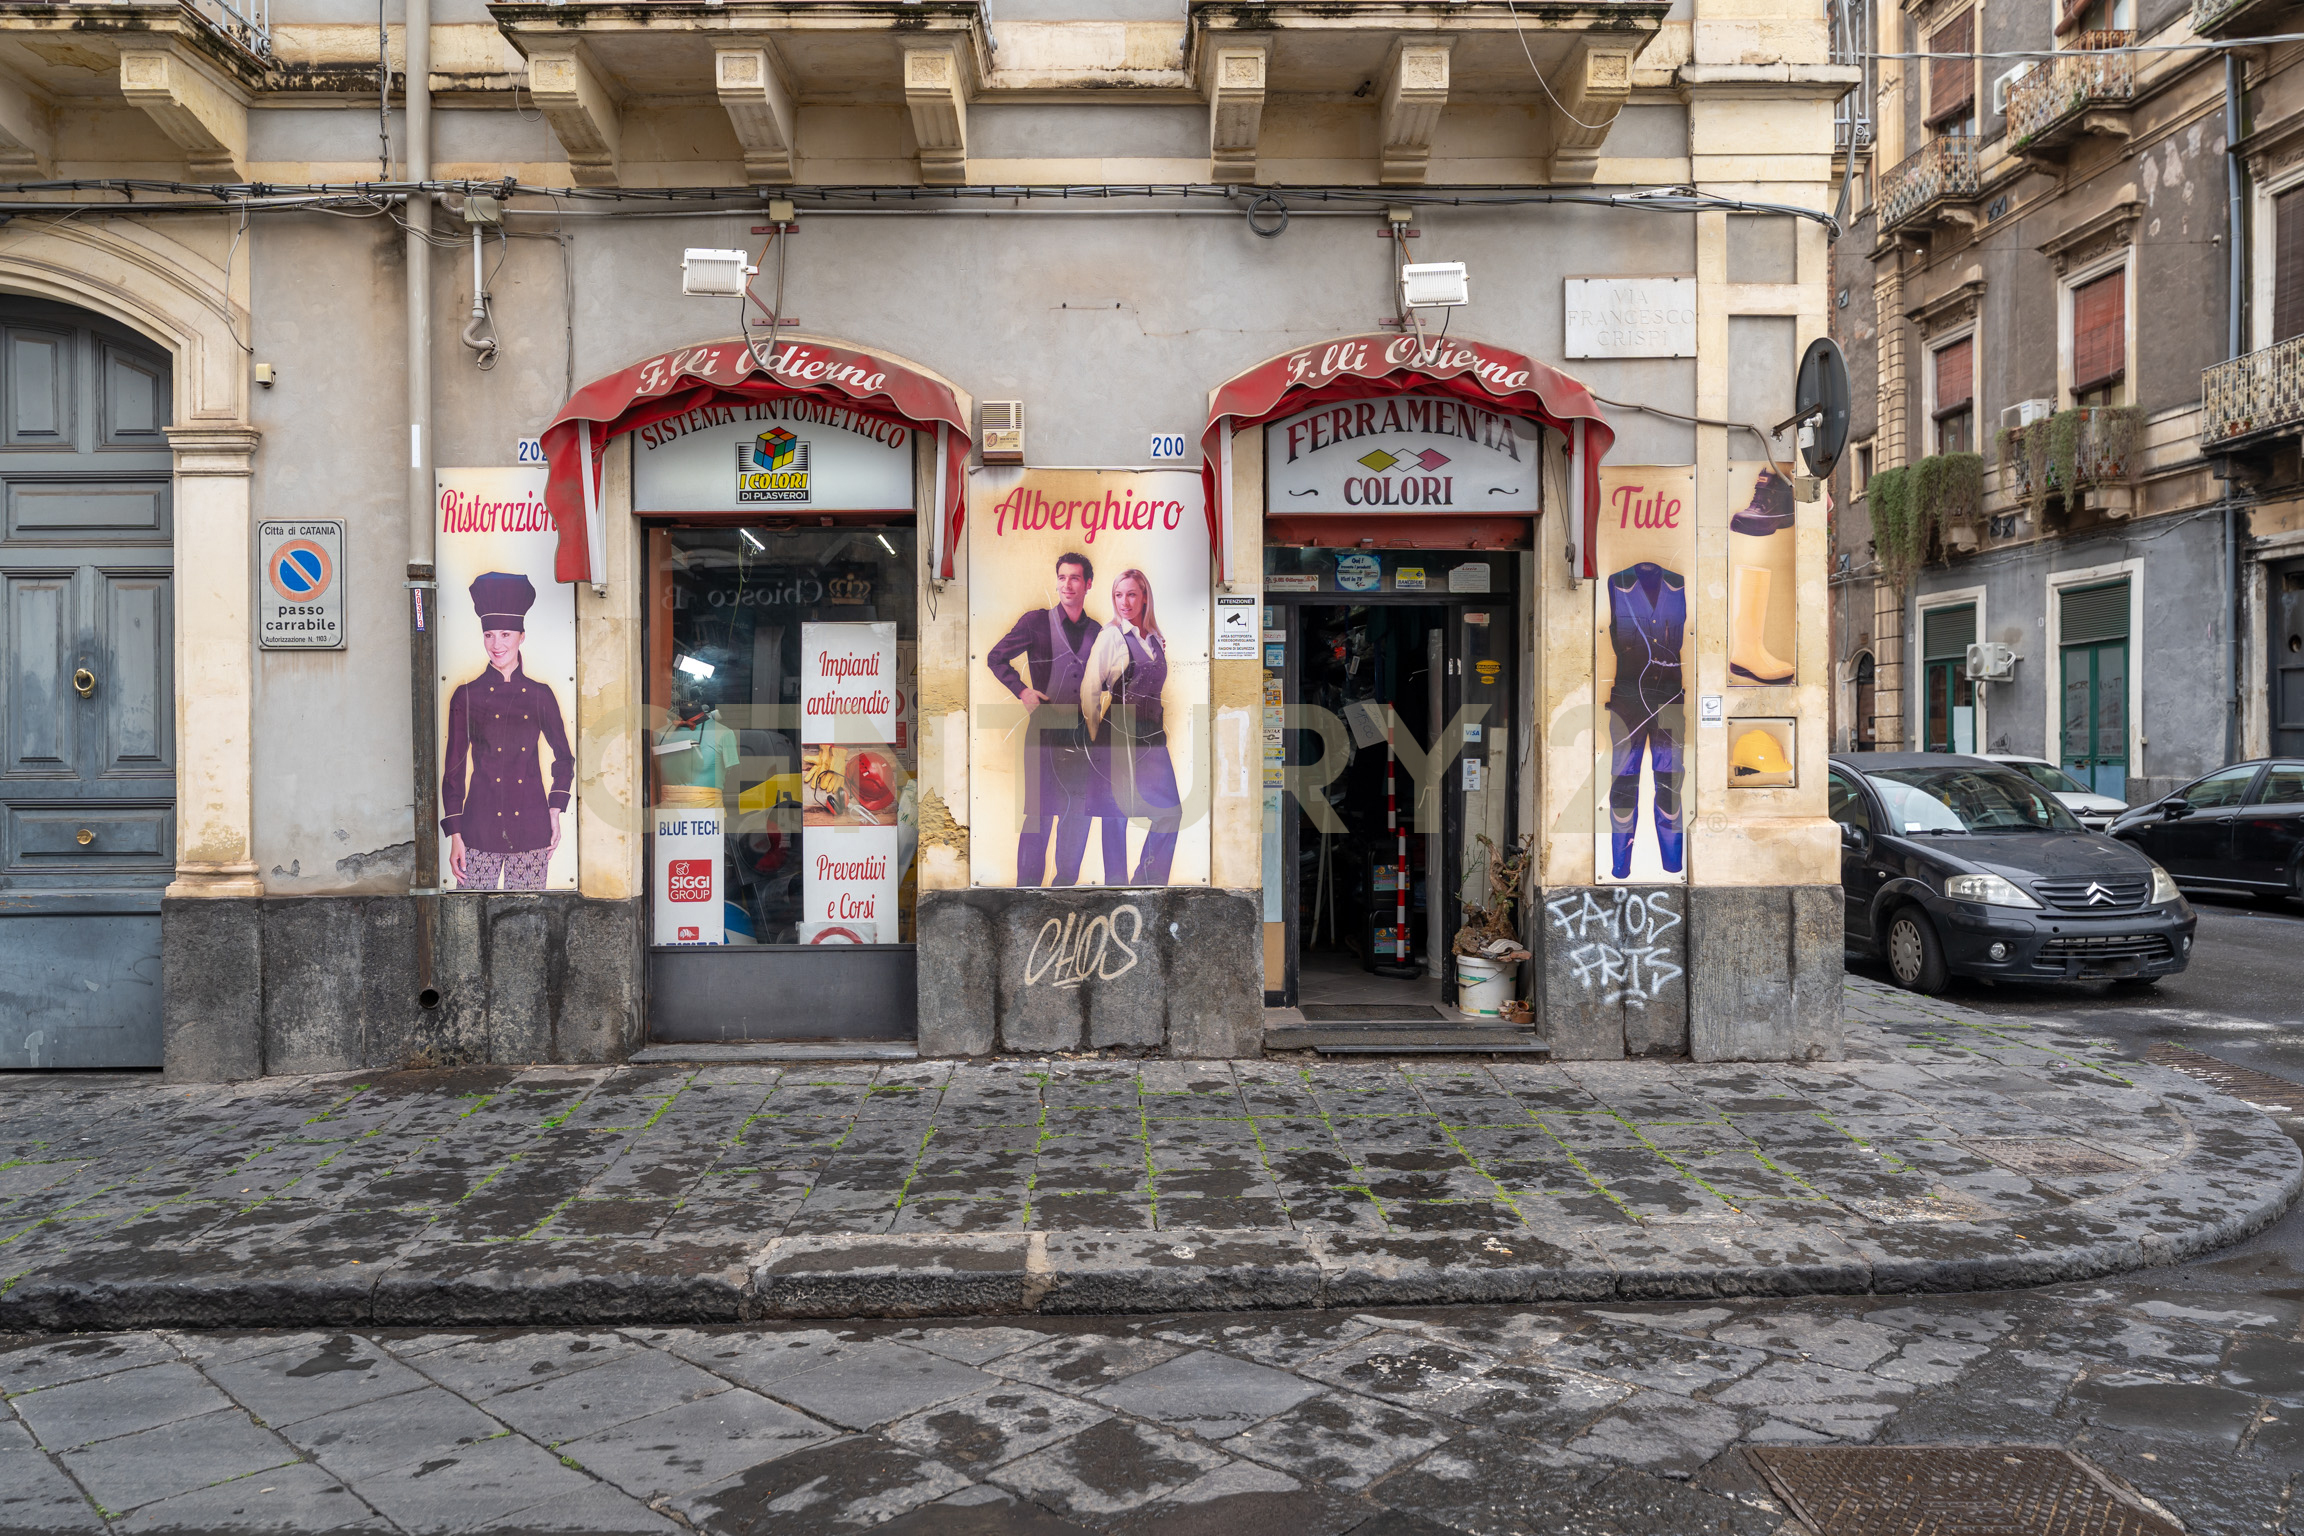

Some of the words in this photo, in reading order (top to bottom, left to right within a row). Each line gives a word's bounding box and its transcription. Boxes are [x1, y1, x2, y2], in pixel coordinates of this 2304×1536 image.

[1613, 289, 1648, 304] VIA
[1566, 309, 1695, 326] FRANCESCO
[1597, 330, 1668, 347] CRISPI
[636, 348, 721, 394] F.lli
[734, 342, 887, 391] Odierno
[1286, 341, 1369, 387] F.lli
[1384, 336, 1530, 388] Odierno
[640, 407, 736, 451] SISTEMA
[743, 399, 906, 449] TINTOMETRICO
[1286, 398, 1521, 465] FERRAMENTA
[1152, 436, 1184, 457] 200
[740, 473, 748, 490] I
[748, 472, 809, 490] COLORI
[1343, 475, 1454, 506] COLORI
[741, 492, 752, 500] DI
[753, 491, 806, 500] PLASVEROI
[993, 486, 1185, 545] Alberghiero
[1612, 485, 1682, 530] Tute
[264, 526, 284, 536] Città
[288, 526, 296, 536] di
[300, 526, 336, 536] CATANIA
[278, 605, 324, 618] passo
[415, 589, 423, 627] 20373
[265, 619, 336, 631] carrabile
[265, 636, 306, 644] Autorizzazione
[818, 650, 881, 685] Impianti
[807, 689, 891, 716] antincendio
[659, 821, 688, 836] BLUE
[692, 820, 720, 836] TECH
[816, 853, 887, 882] Preventivi
[670, 876, 710, 889] SIGGI
[670, 889, 711, 901] GROUP
[827, 900, 835, 919] e
[839, 892, 876, 920] Corsi
